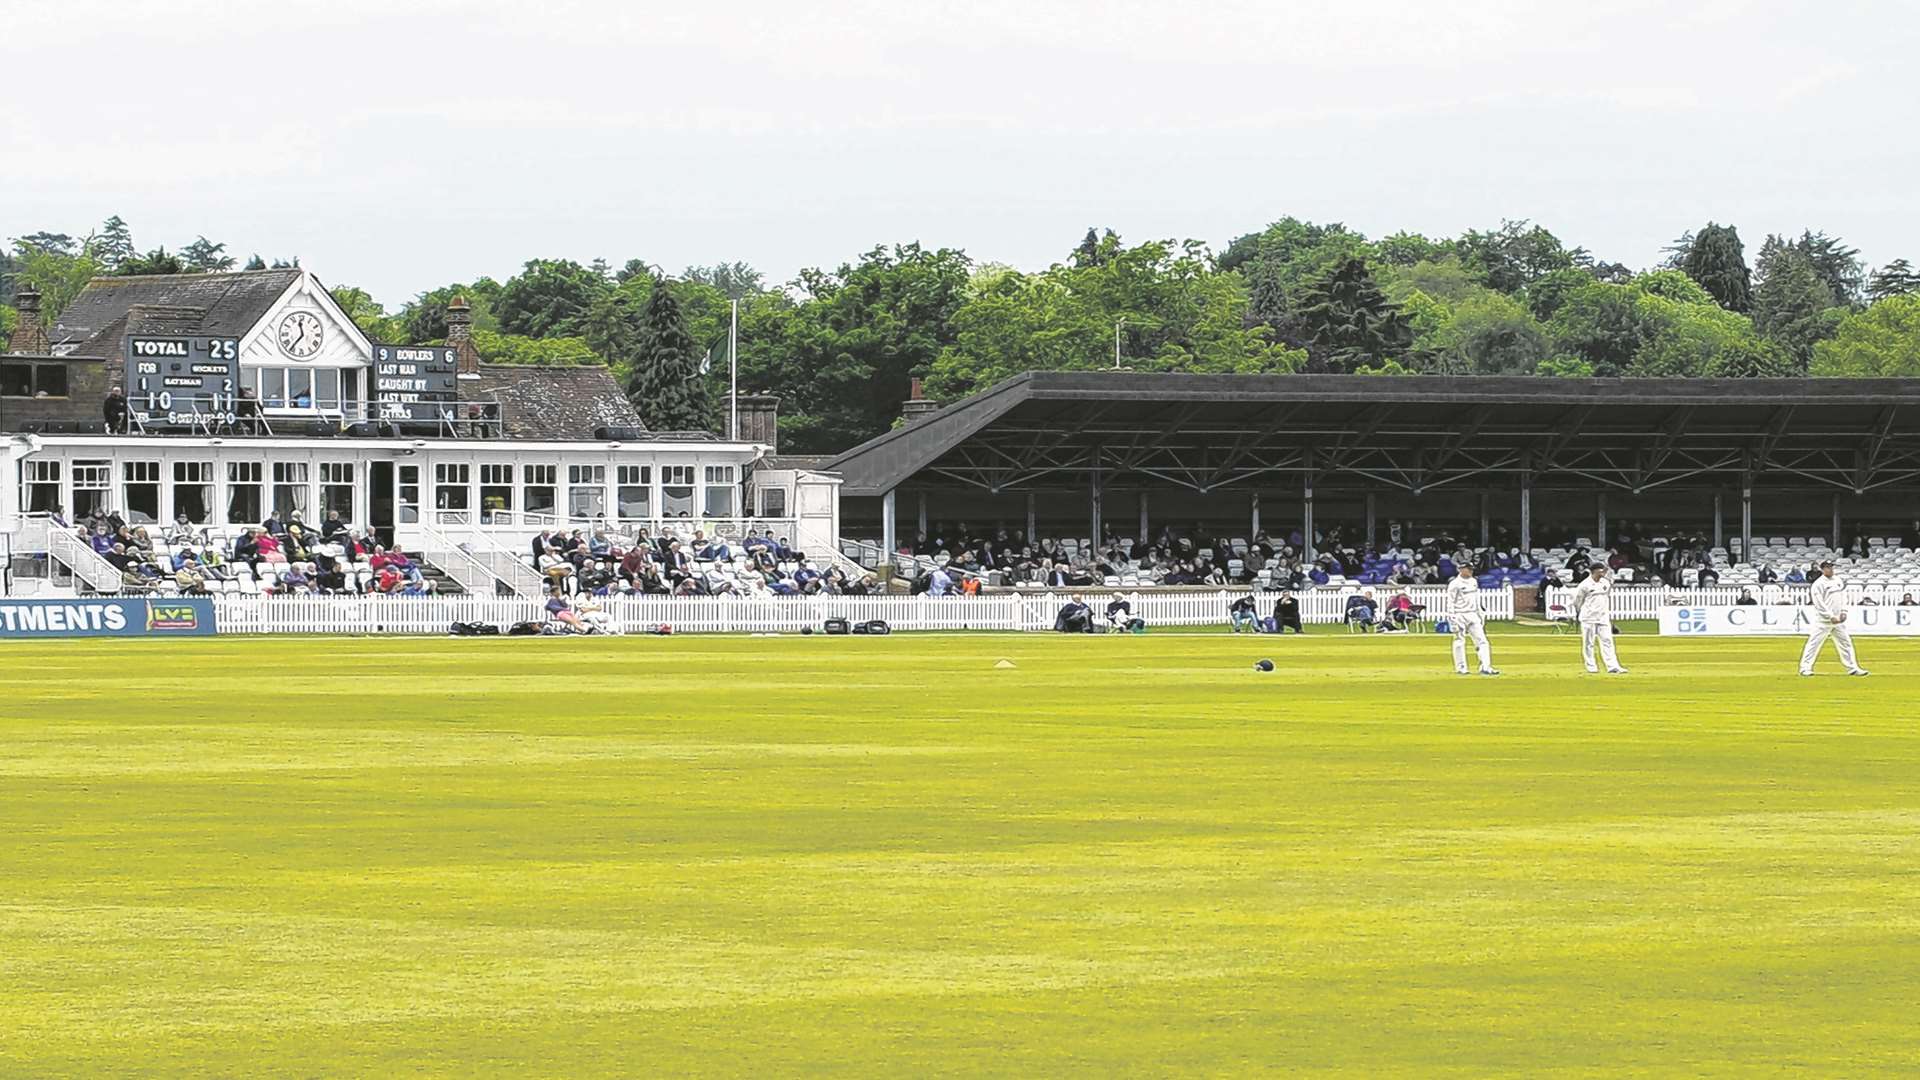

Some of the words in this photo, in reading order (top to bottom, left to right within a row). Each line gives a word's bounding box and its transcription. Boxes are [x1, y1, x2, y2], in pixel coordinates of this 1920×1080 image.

[134, 341, 187, 355] TOTAL
[210, 340, 235, 359] 25
[379, 349, 388, 360] 9
[396, 350, 434, 361] BOWLERS
[444, 351, 454, 363] 6
[138, 363, 157, 374] FOR
[378, 364, 397, 375] LAST
[142, 377, 147, 390] 1
[164, 378, 202, 386] BATSMAN
[223, 379, 232, 392] 2
[378, 379, 413, 391] CAUGHT
[414, 379, 427, 391] BY
[149, 391, 172, 410] 10
[378, 393, 399, 402] LAST
[0, 604, 126, 631] TMENTS
[1727, 608, 1911, 626] CLAUE
